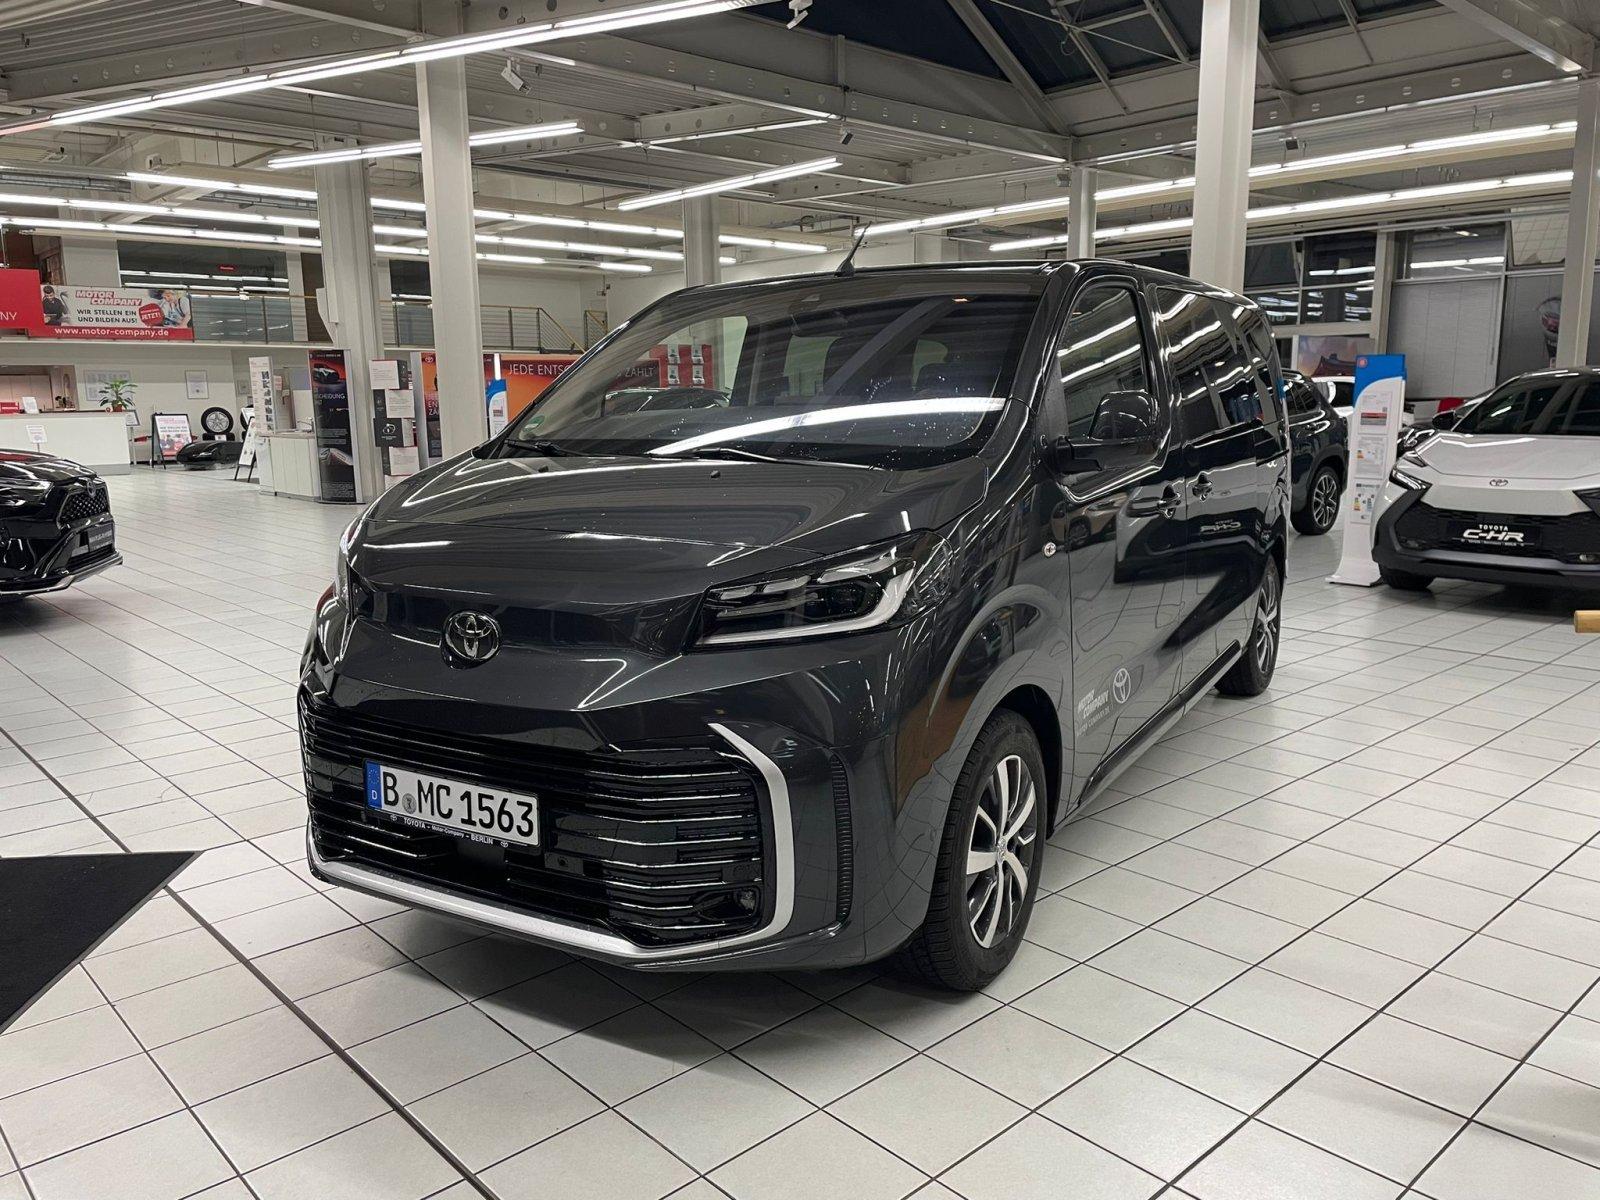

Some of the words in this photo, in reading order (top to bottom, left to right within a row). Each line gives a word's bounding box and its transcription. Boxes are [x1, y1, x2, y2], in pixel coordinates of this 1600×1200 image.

[75, 290, 115, 299] MOTOR
[91, 298, 142, 306] COMPANY
[0, 312, 17, 320] NY
[54, 327, 169, 337] www.motor-company.de
[509, 364, 534, 375] JEDE
[1479, 524, 1509, 532] TOYOTA
[1462, 528, 1524, 542] C-HR
[371, 789, 378, 800] D
[382, 771, 400, 807] B
[417, 779, 453, 819] MC
[459, 790, 534, 838] 1563
[402, 816, 426, 829] TOYOTA
[470, 834, 494, 845] BERLIN
